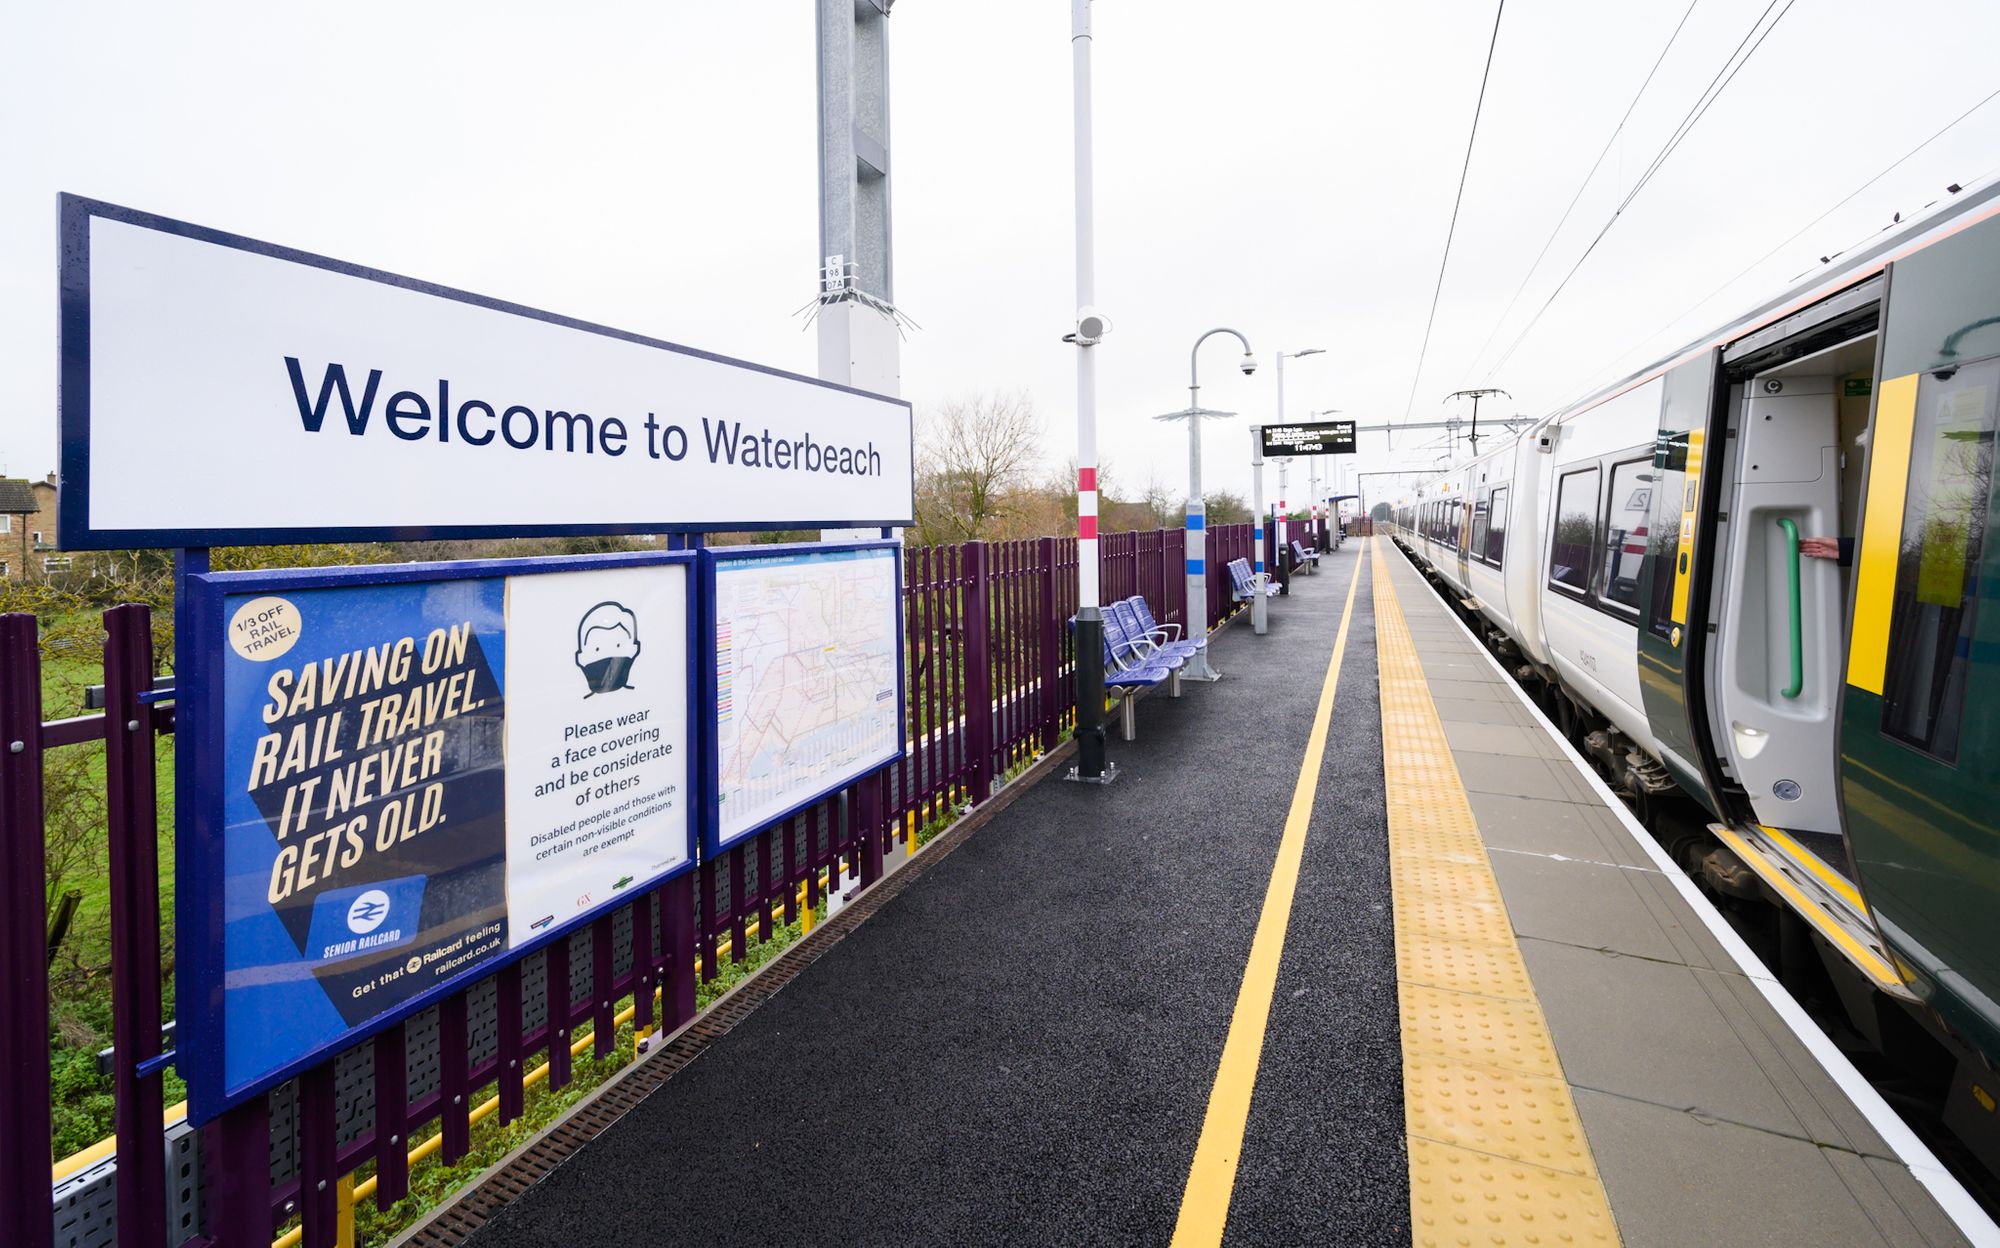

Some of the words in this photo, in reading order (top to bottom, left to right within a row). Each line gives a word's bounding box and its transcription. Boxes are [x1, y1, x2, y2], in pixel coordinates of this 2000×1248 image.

[284, 356, 629, 458] Welcome
[644, 412, 689, 462] to
[701, 416, 882, 478] Waterbeach
[237, 614, 257, 632] 1/3
[258, 604, 284, 624] OFF
[244, 626, 296, 654] TRAVEL
[249, 621, 283, 640] RAIL
[262, 637, 415, 724] SAVING
[421, 621, 471, 675] ON
[247, 711, 342, 793] RAIL
[356, 669, 485, 751] TRAVEL.
[551, 756, 561, 768] a
[565, 745, 597, 765] face
[601, 726, 660, 754] covering
[564, 719, 613, 742] Please
[617, 709, 650, 728] wear
[277, 776, 321, 841] IT
[325, 730, 445, 821] NEVER
[534, 773, 566, 797] and
[570, 769, 589, 786] be
[593, 743, 673, 778] considerate
[575, 785, 591, 806] of
[595, 774, 641, 800] others
[530, 820, 576, 847] Disabled
[579, 809, 611, 832] people
[613, 800, 630, 815] and
[632, 792, 656, 810] those
[657, 784, 676, 800] with
[535, 839, 573, 861] certain
[575, 817, 626, 846] non-visible
[628, 801, 673, 824] conditions
[268, 814, 368, 904] GETS
[375, 782, 447, 853] OLD.
[583, 845, 599, 857] are
[601, 828, 636, 850] exempt
[323, 940, 357, 959] SENIOR
[358, 929, 401, 950] RAILCARD
[352, 980, 376, 998] Get
[379, 966, 405, 986] that
[423, 939, 463, 965] Railcard
[465, 922, 501, 946] feeling
[435, 937, 501, 976] railcard.co.uk
